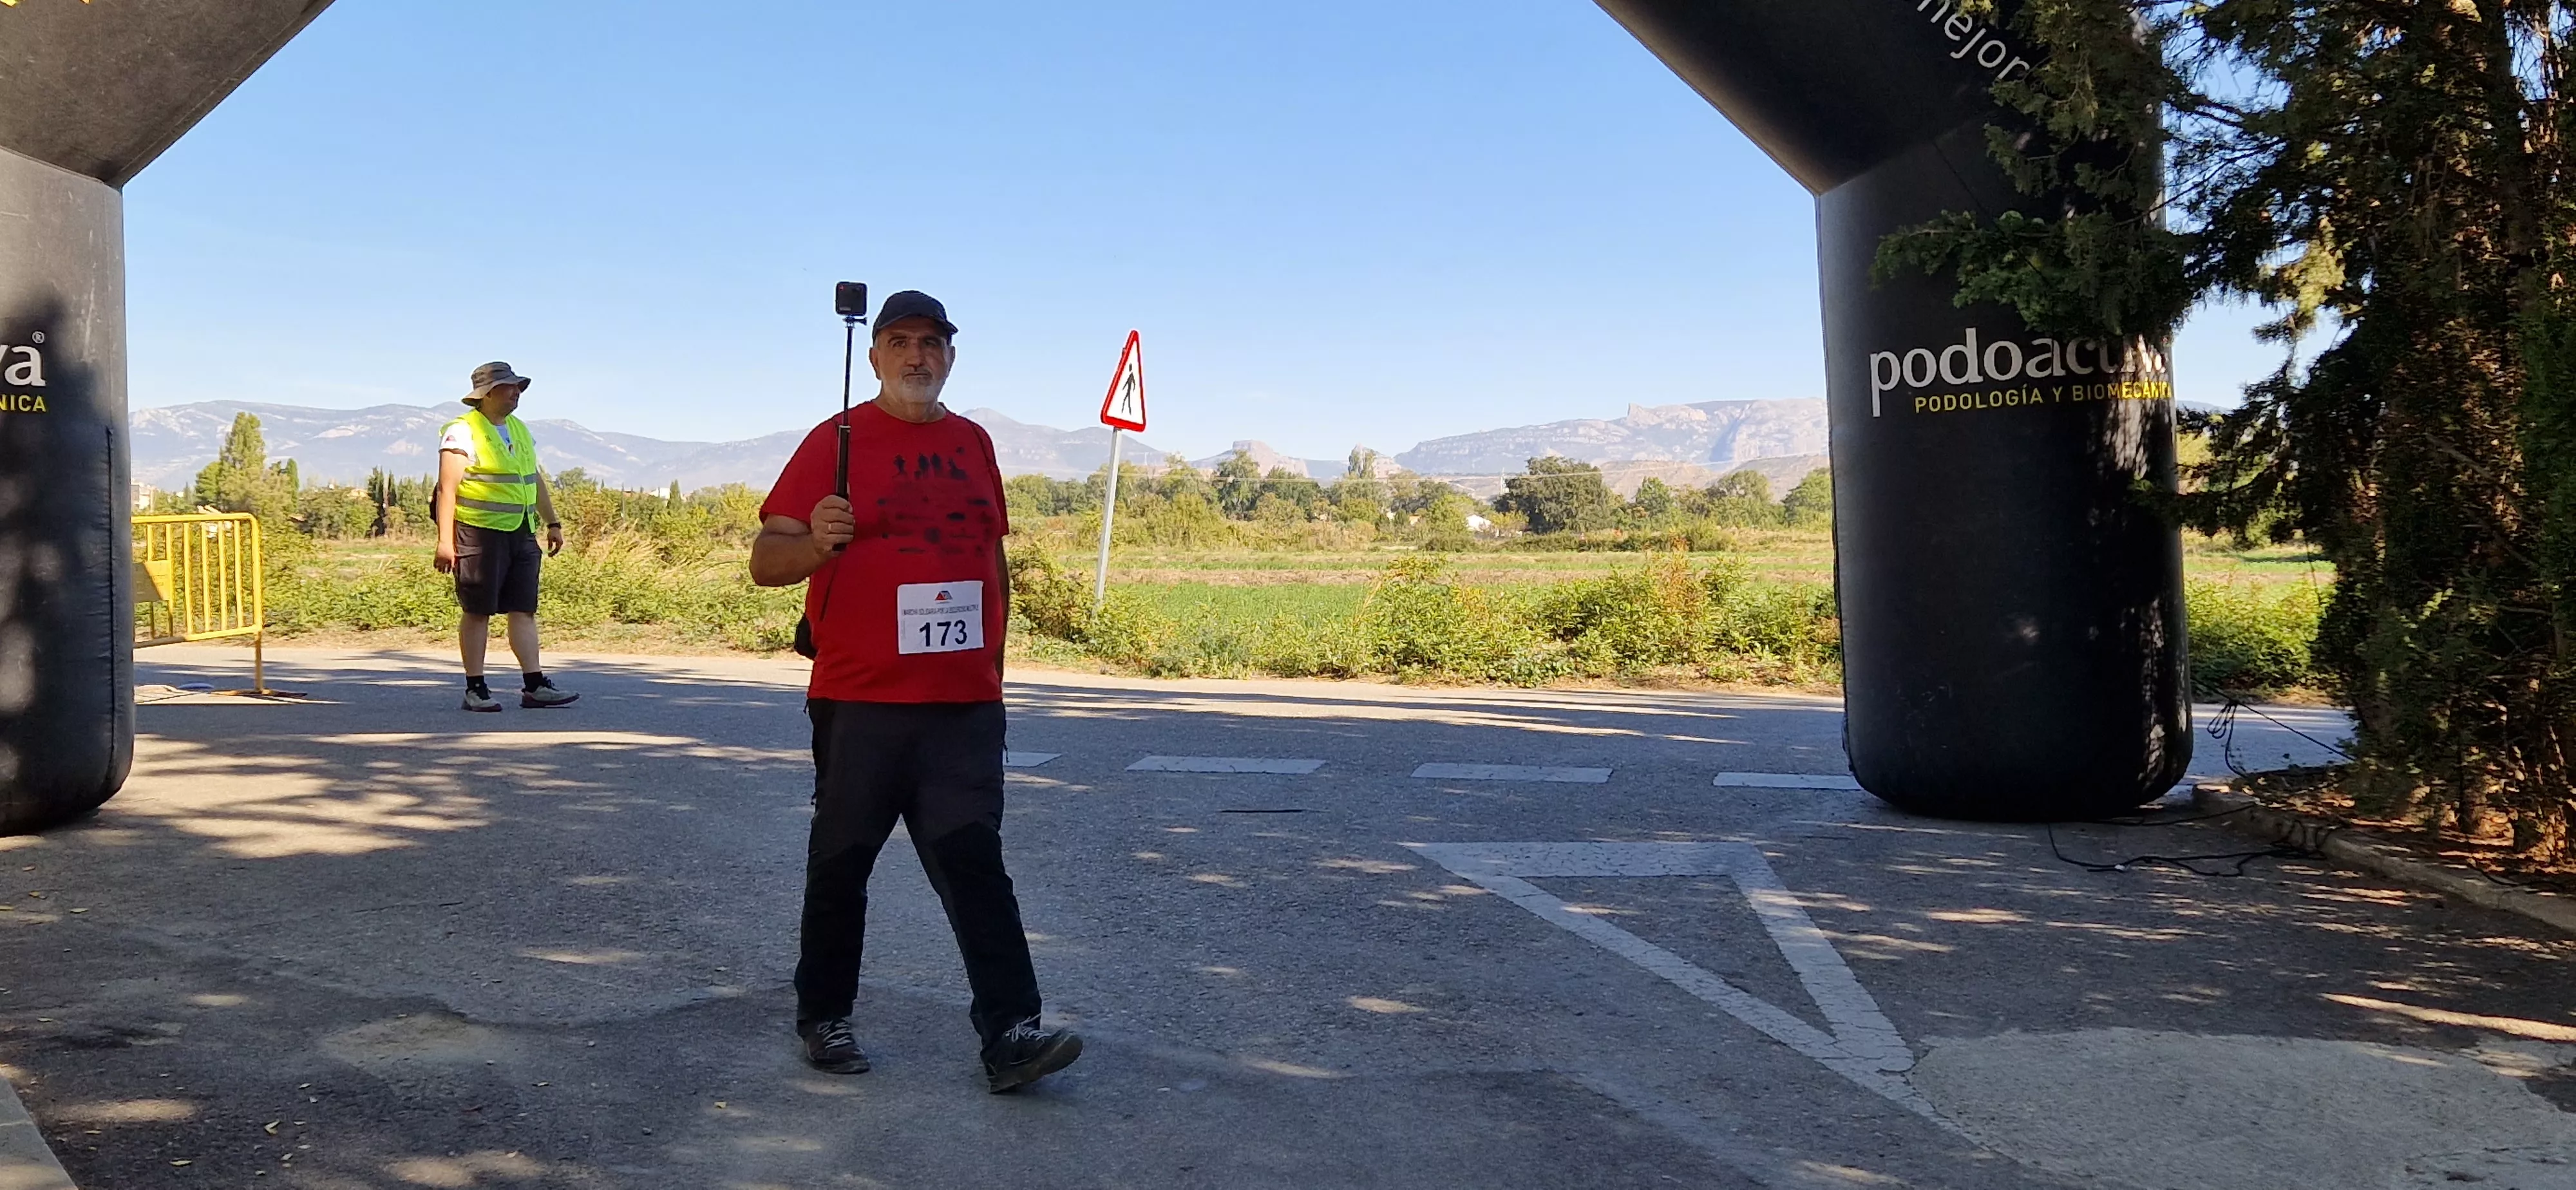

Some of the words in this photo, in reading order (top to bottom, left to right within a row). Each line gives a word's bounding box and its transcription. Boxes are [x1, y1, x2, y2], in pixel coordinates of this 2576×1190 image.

[1915, 383, 2043, 413] PODOLOGÍA
[2052, 386, 2063, 402] Y
[919, 619, 967, 647] 173
